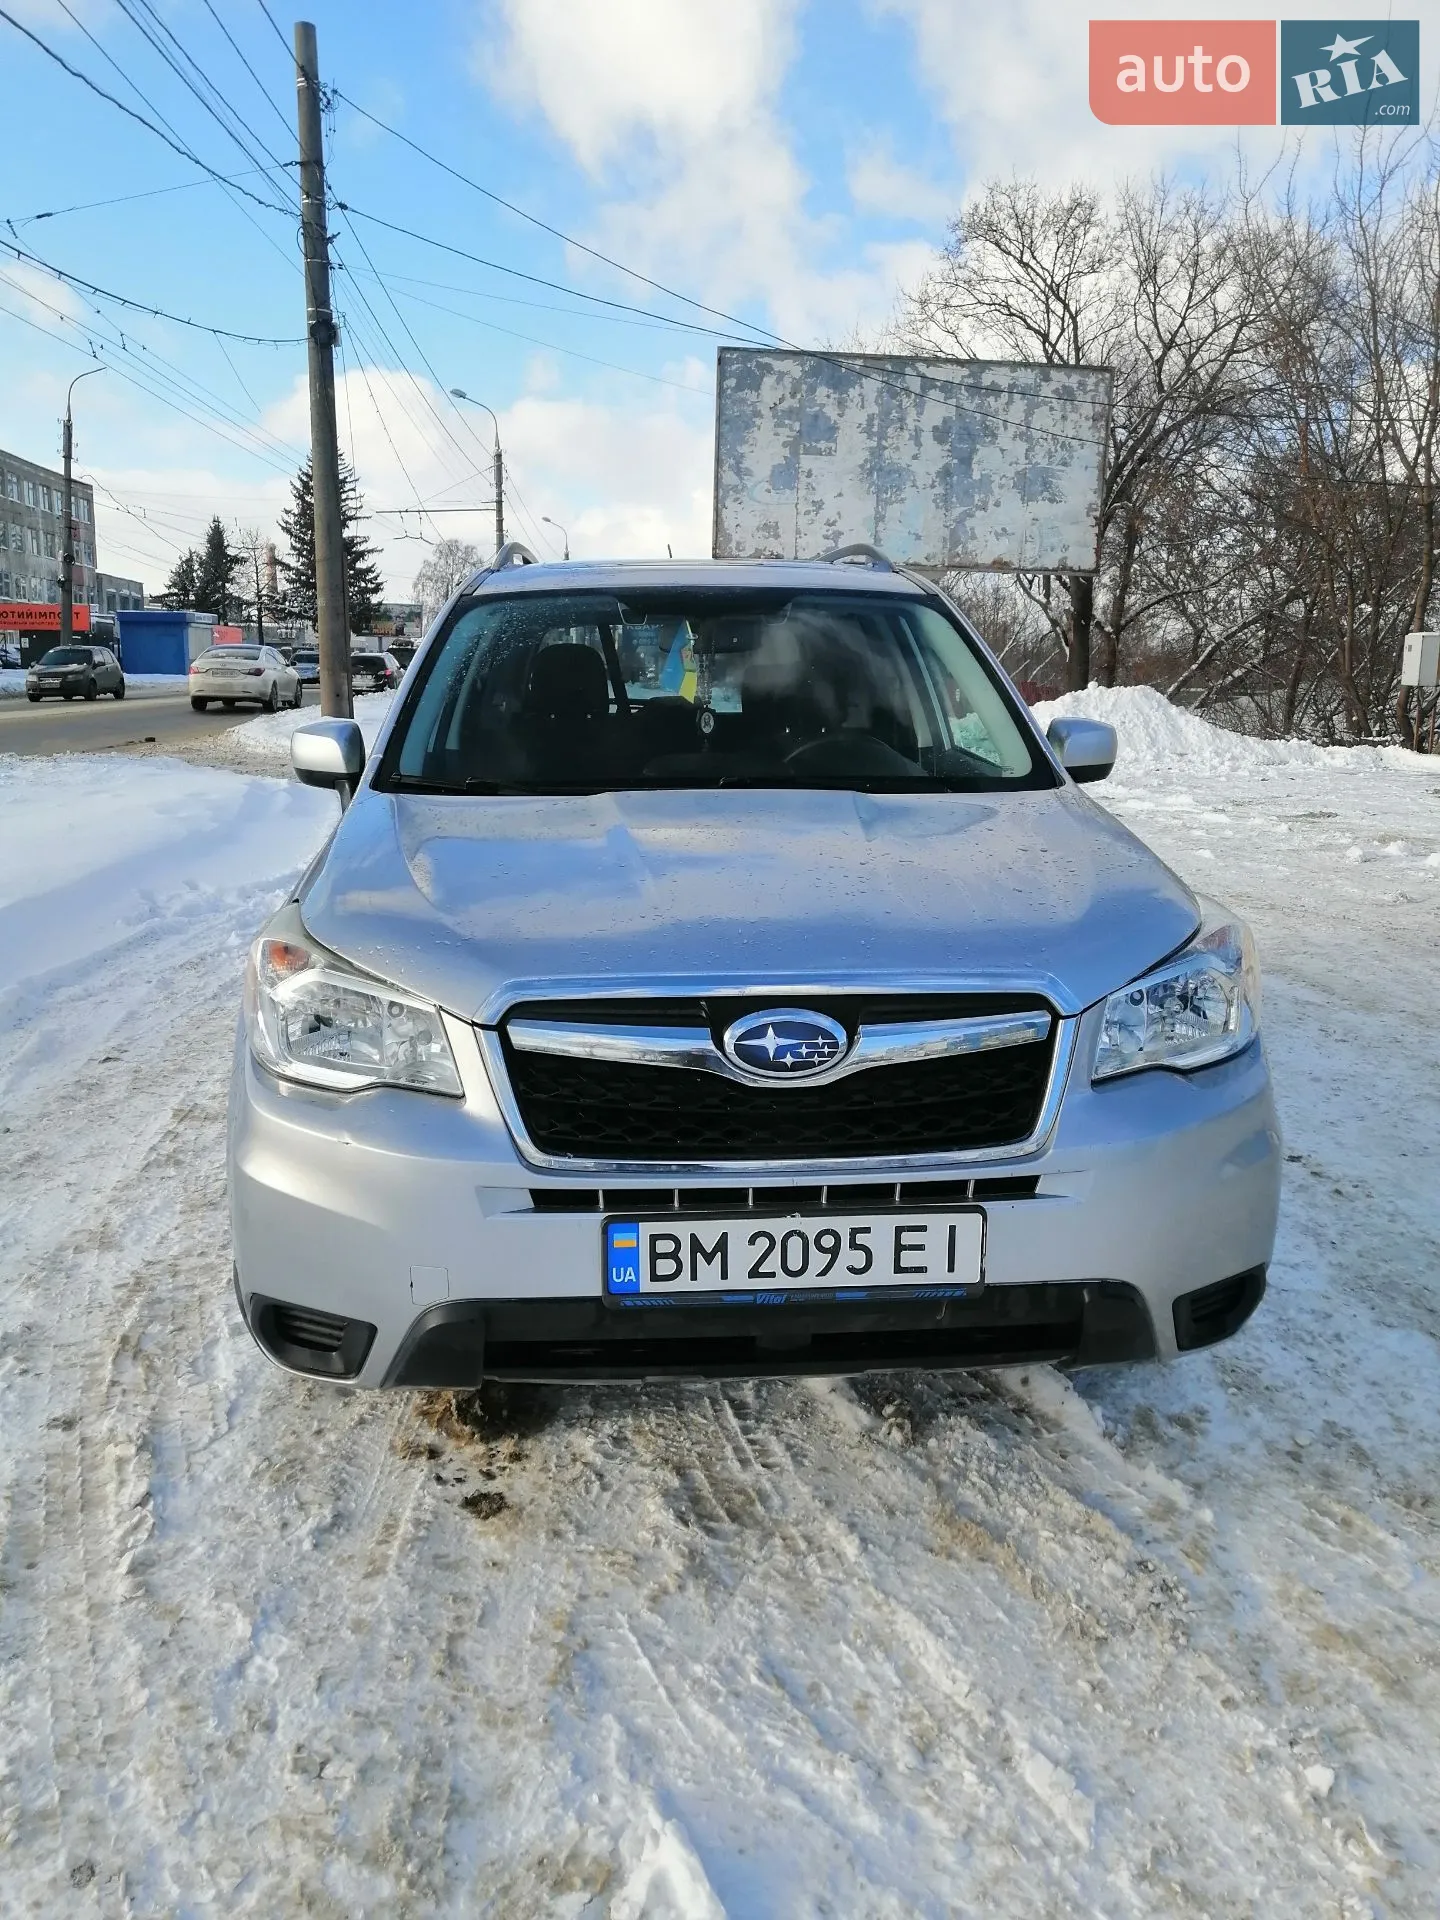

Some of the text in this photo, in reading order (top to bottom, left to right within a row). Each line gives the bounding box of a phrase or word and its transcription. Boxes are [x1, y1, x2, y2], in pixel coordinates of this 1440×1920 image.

[648, 1224, 957, 1282] BM 2095 EI
[612, 1266, 636, 1282] UA
